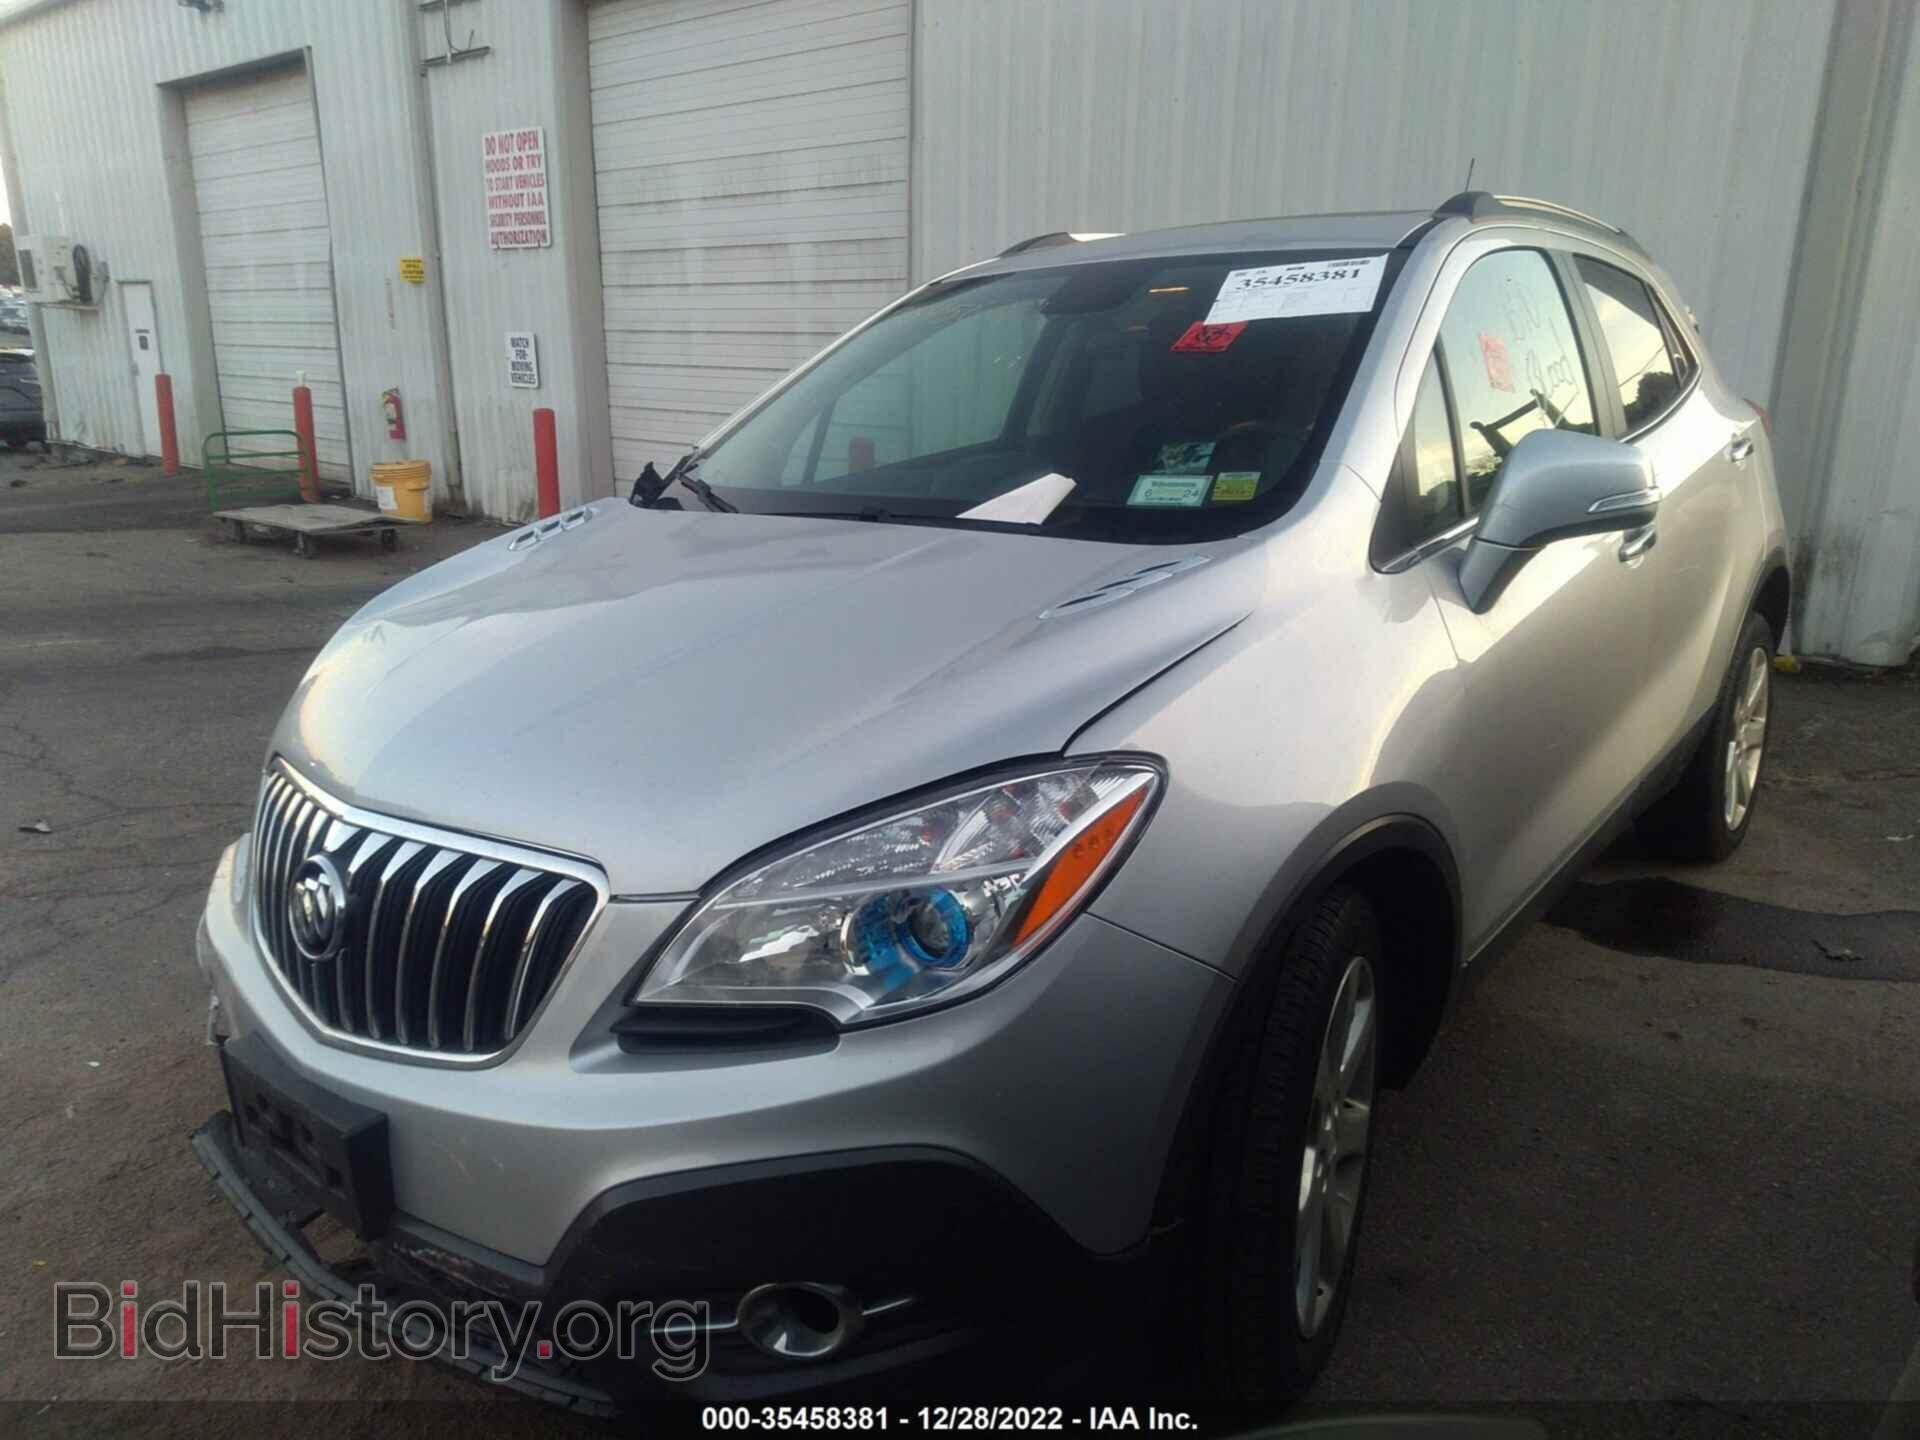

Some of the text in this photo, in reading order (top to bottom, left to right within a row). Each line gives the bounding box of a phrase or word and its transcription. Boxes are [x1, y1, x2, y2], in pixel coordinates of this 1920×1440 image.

[485, 130, 539, 156] DO NOT OPEN
[486, 154, 542, 173] HOODS OR TRY
[495, 176, 513, 191] START
[515, 173, 545, 189] VEHICLES
[488, 191, 544, 209] WITHOUT IAA
[489, 211, 546, 228] SECURITY PERSONNEL
[490, 229, 547, 246] AUTHORIZATION
[1235, 268, 1361, 290] 35458381
[511, 373, 536, 384] VEHICLES
